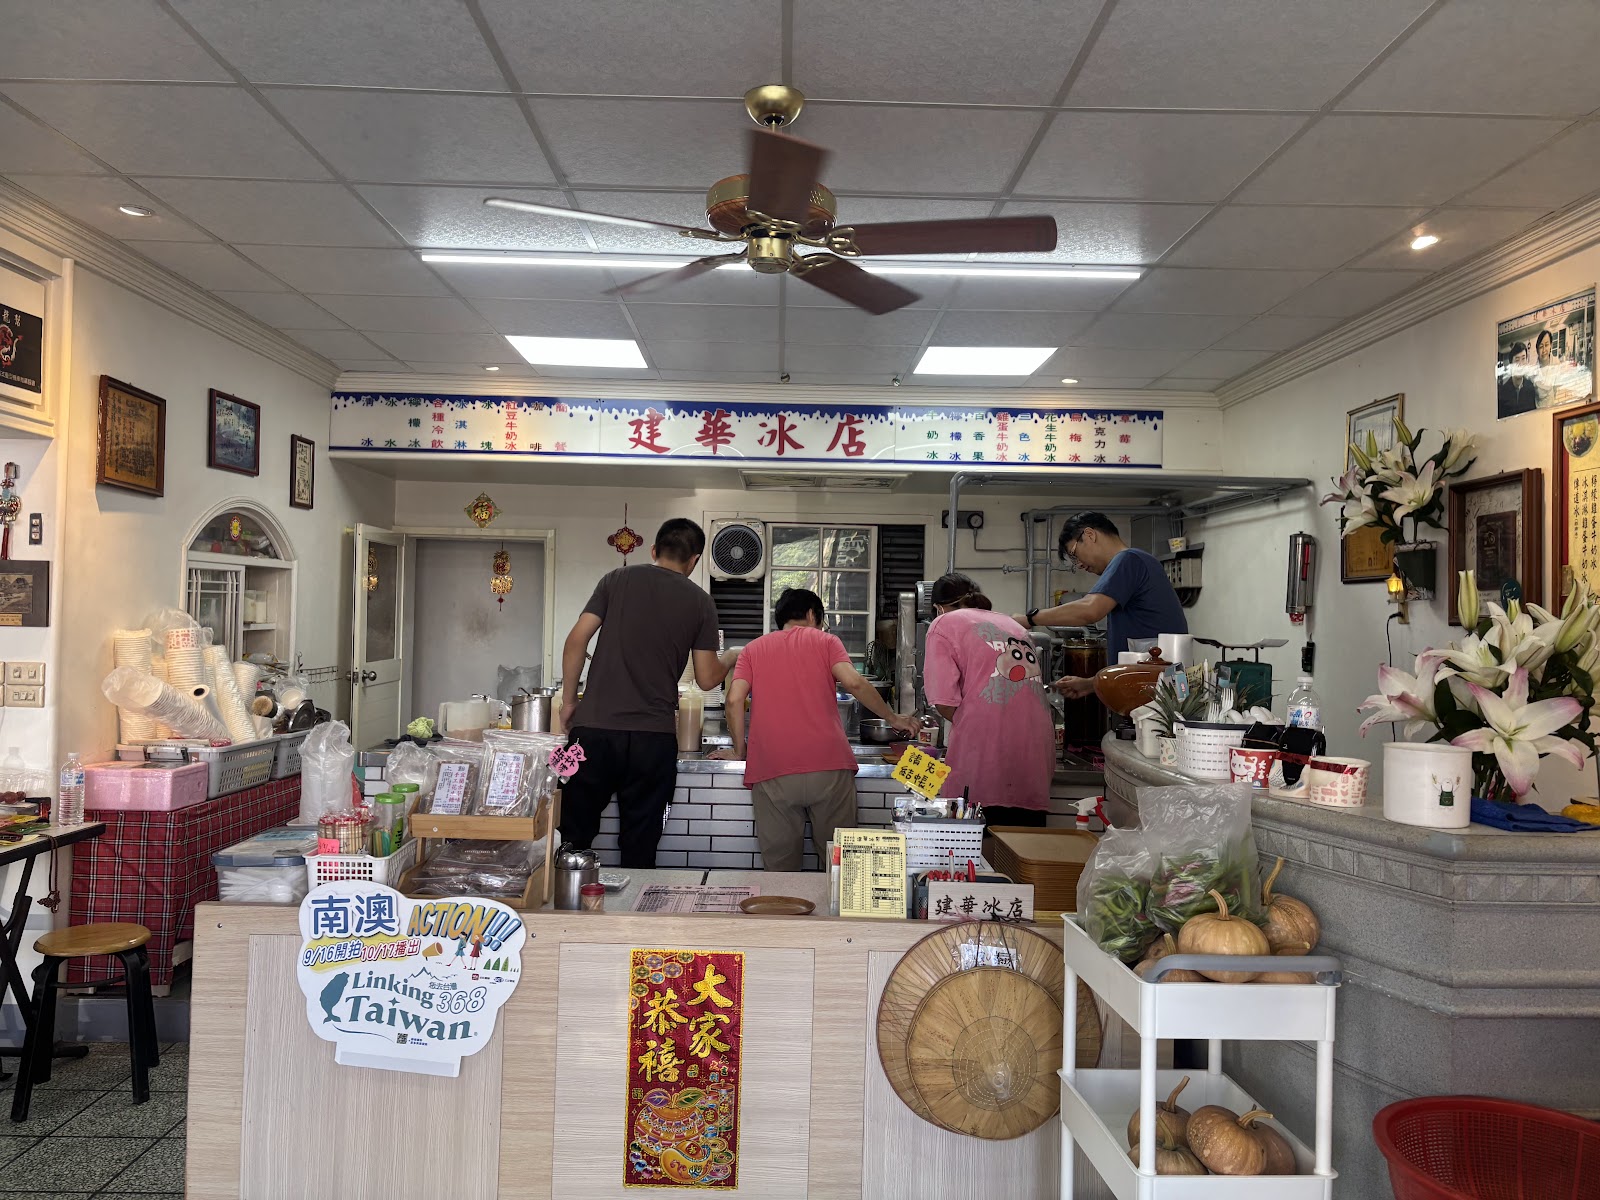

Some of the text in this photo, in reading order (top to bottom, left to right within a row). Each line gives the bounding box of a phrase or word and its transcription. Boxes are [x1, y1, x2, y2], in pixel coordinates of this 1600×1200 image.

[384, 397, 397, 448] 冰水
[408, 397, 421, 448] 檸檬冰
[431, 398, 445, 448] 各種冷飲
[454, 399, 468, 450] 冰淇淋
[480, 400, 493, 451] 冰塊
[505, 401, 518, 451] 紅豆牛奶冰
[530, 401, 544, 452] 咖啡
[627, 406, 868, 457] 建華冰店
[926, 410, 939, 460] 牛奶冰
[972, 411, 985, 461] 百香果
[995, 411, 1009, 462] 雞蛋牛奶冰
[1017, 413, 1031, 462] 三色冰
[1043, 412, 1057, 463] 花生牛奶冰
[1068, 413, 1082, 463] 烏梅冰
[1093, 413, 1107, 463] 巧克力冰
[1118, 414, 1131, 464] 草莓冰
[475, 502, 490, 520] 福
[909, 751, 936, 774] 請先
[311, 893, 395, 936] 南澳
[407, 902, 521, 951] ACTION!!
[935, 894, 1023, 920] 建華冰店
[352, 971, 487, 1014] Linking 368
[687, 963, 734, 1059] 大家
[345, 995, 473, 1041] Taiwan
[638, 987, 688, 1083] 恭禧
